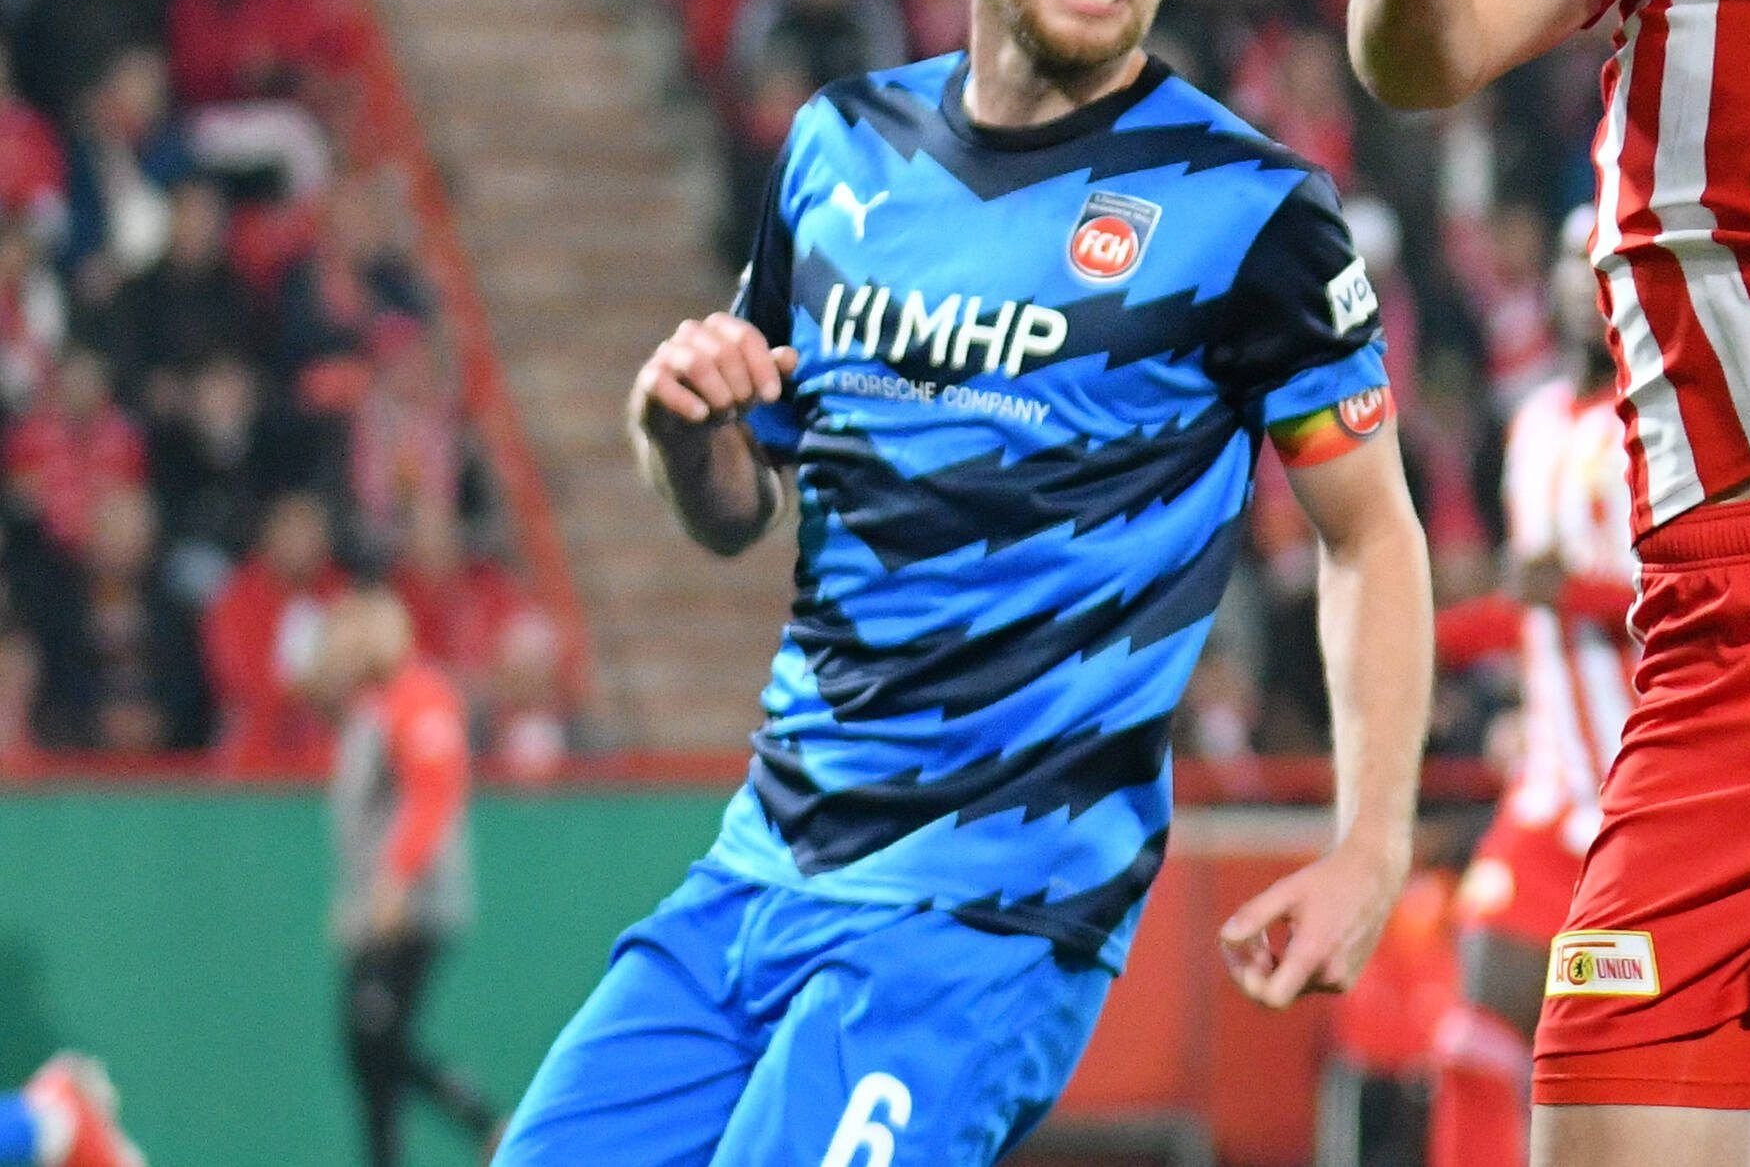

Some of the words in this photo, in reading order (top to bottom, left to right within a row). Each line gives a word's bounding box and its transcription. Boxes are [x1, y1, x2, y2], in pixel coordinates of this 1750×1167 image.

[1079, 229, 1131, 266] FCH
[889, 288, 1068, 378] MHP
[840, 370, 937, 403] PORSCHE
[942, 384, 1050, 426] COMPANY
[1596, 958, 1643, 980] UNION
[818, 1071, 913, 1167] 6
